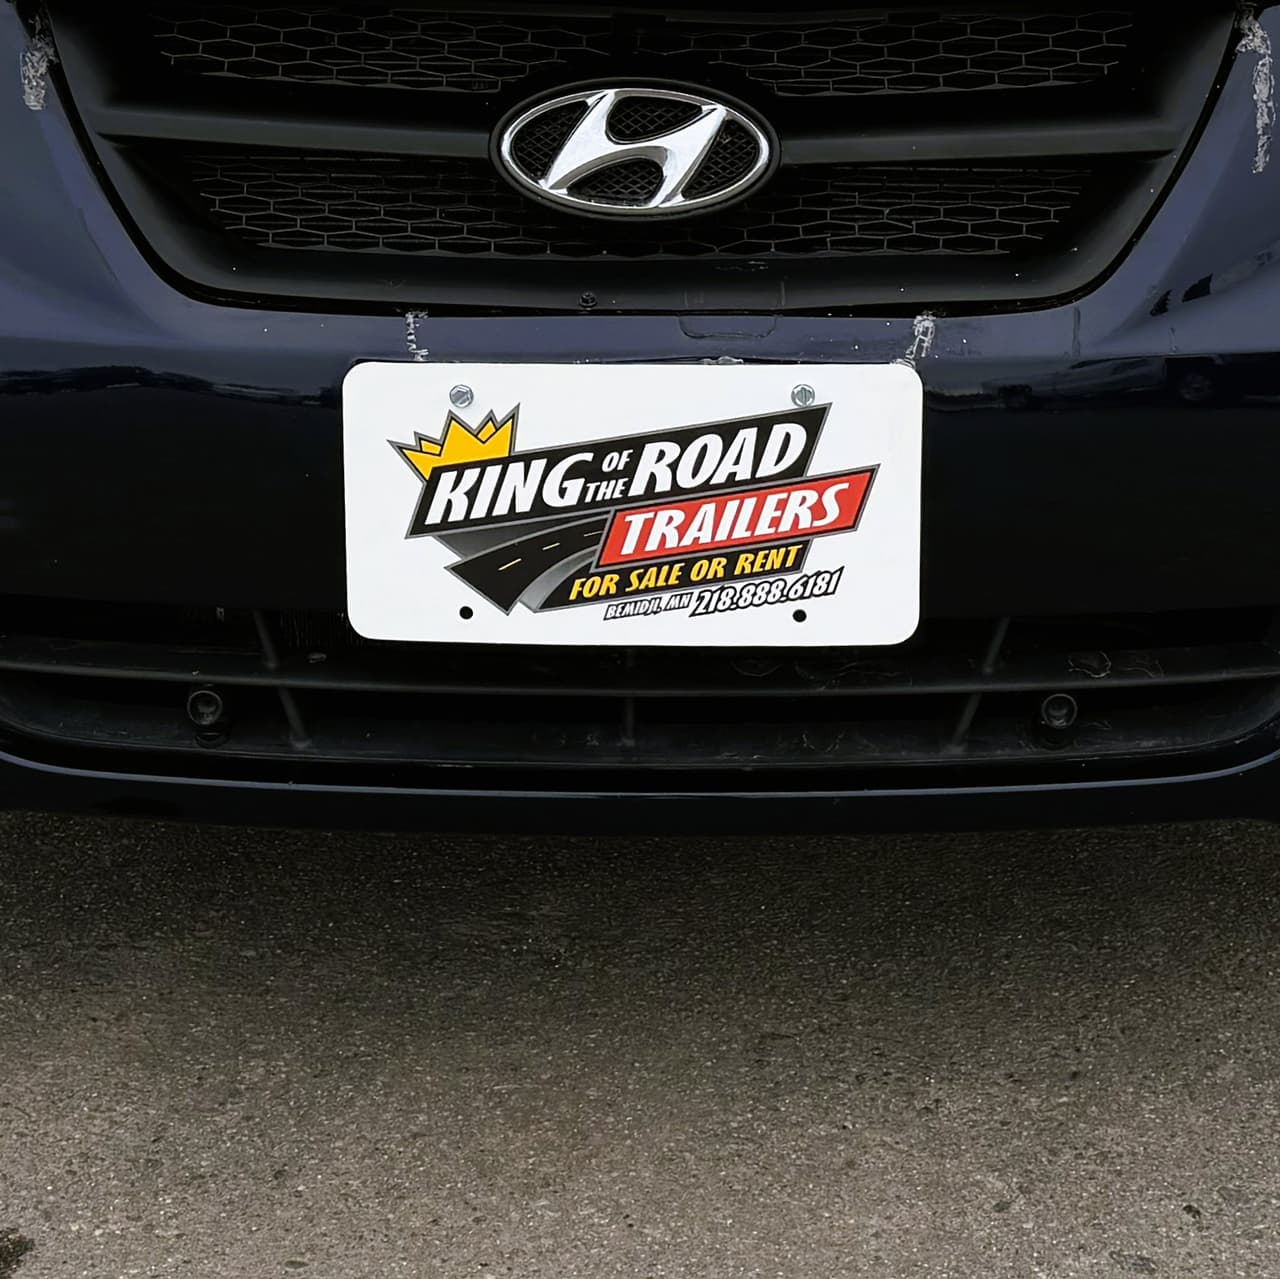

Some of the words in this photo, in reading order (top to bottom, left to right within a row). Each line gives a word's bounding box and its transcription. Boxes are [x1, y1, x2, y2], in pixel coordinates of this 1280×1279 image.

[601, 449, 634, 472] OF
[628, 423, 807, 497] ROAD
[424, 452, 594, 525] KING
[584, 477, 629, 503] THE
[620, 482, 849, 556] TRAILERS
[569, 574, 620, 600] FOR
[626, 563, 685, 592] SALE
[690, 556, 725, 581] OR
[734, 544, 803, 576] RENT
[666, 592, 691, 611] MN
[694, 570, 840, 615] 218.888.6181
